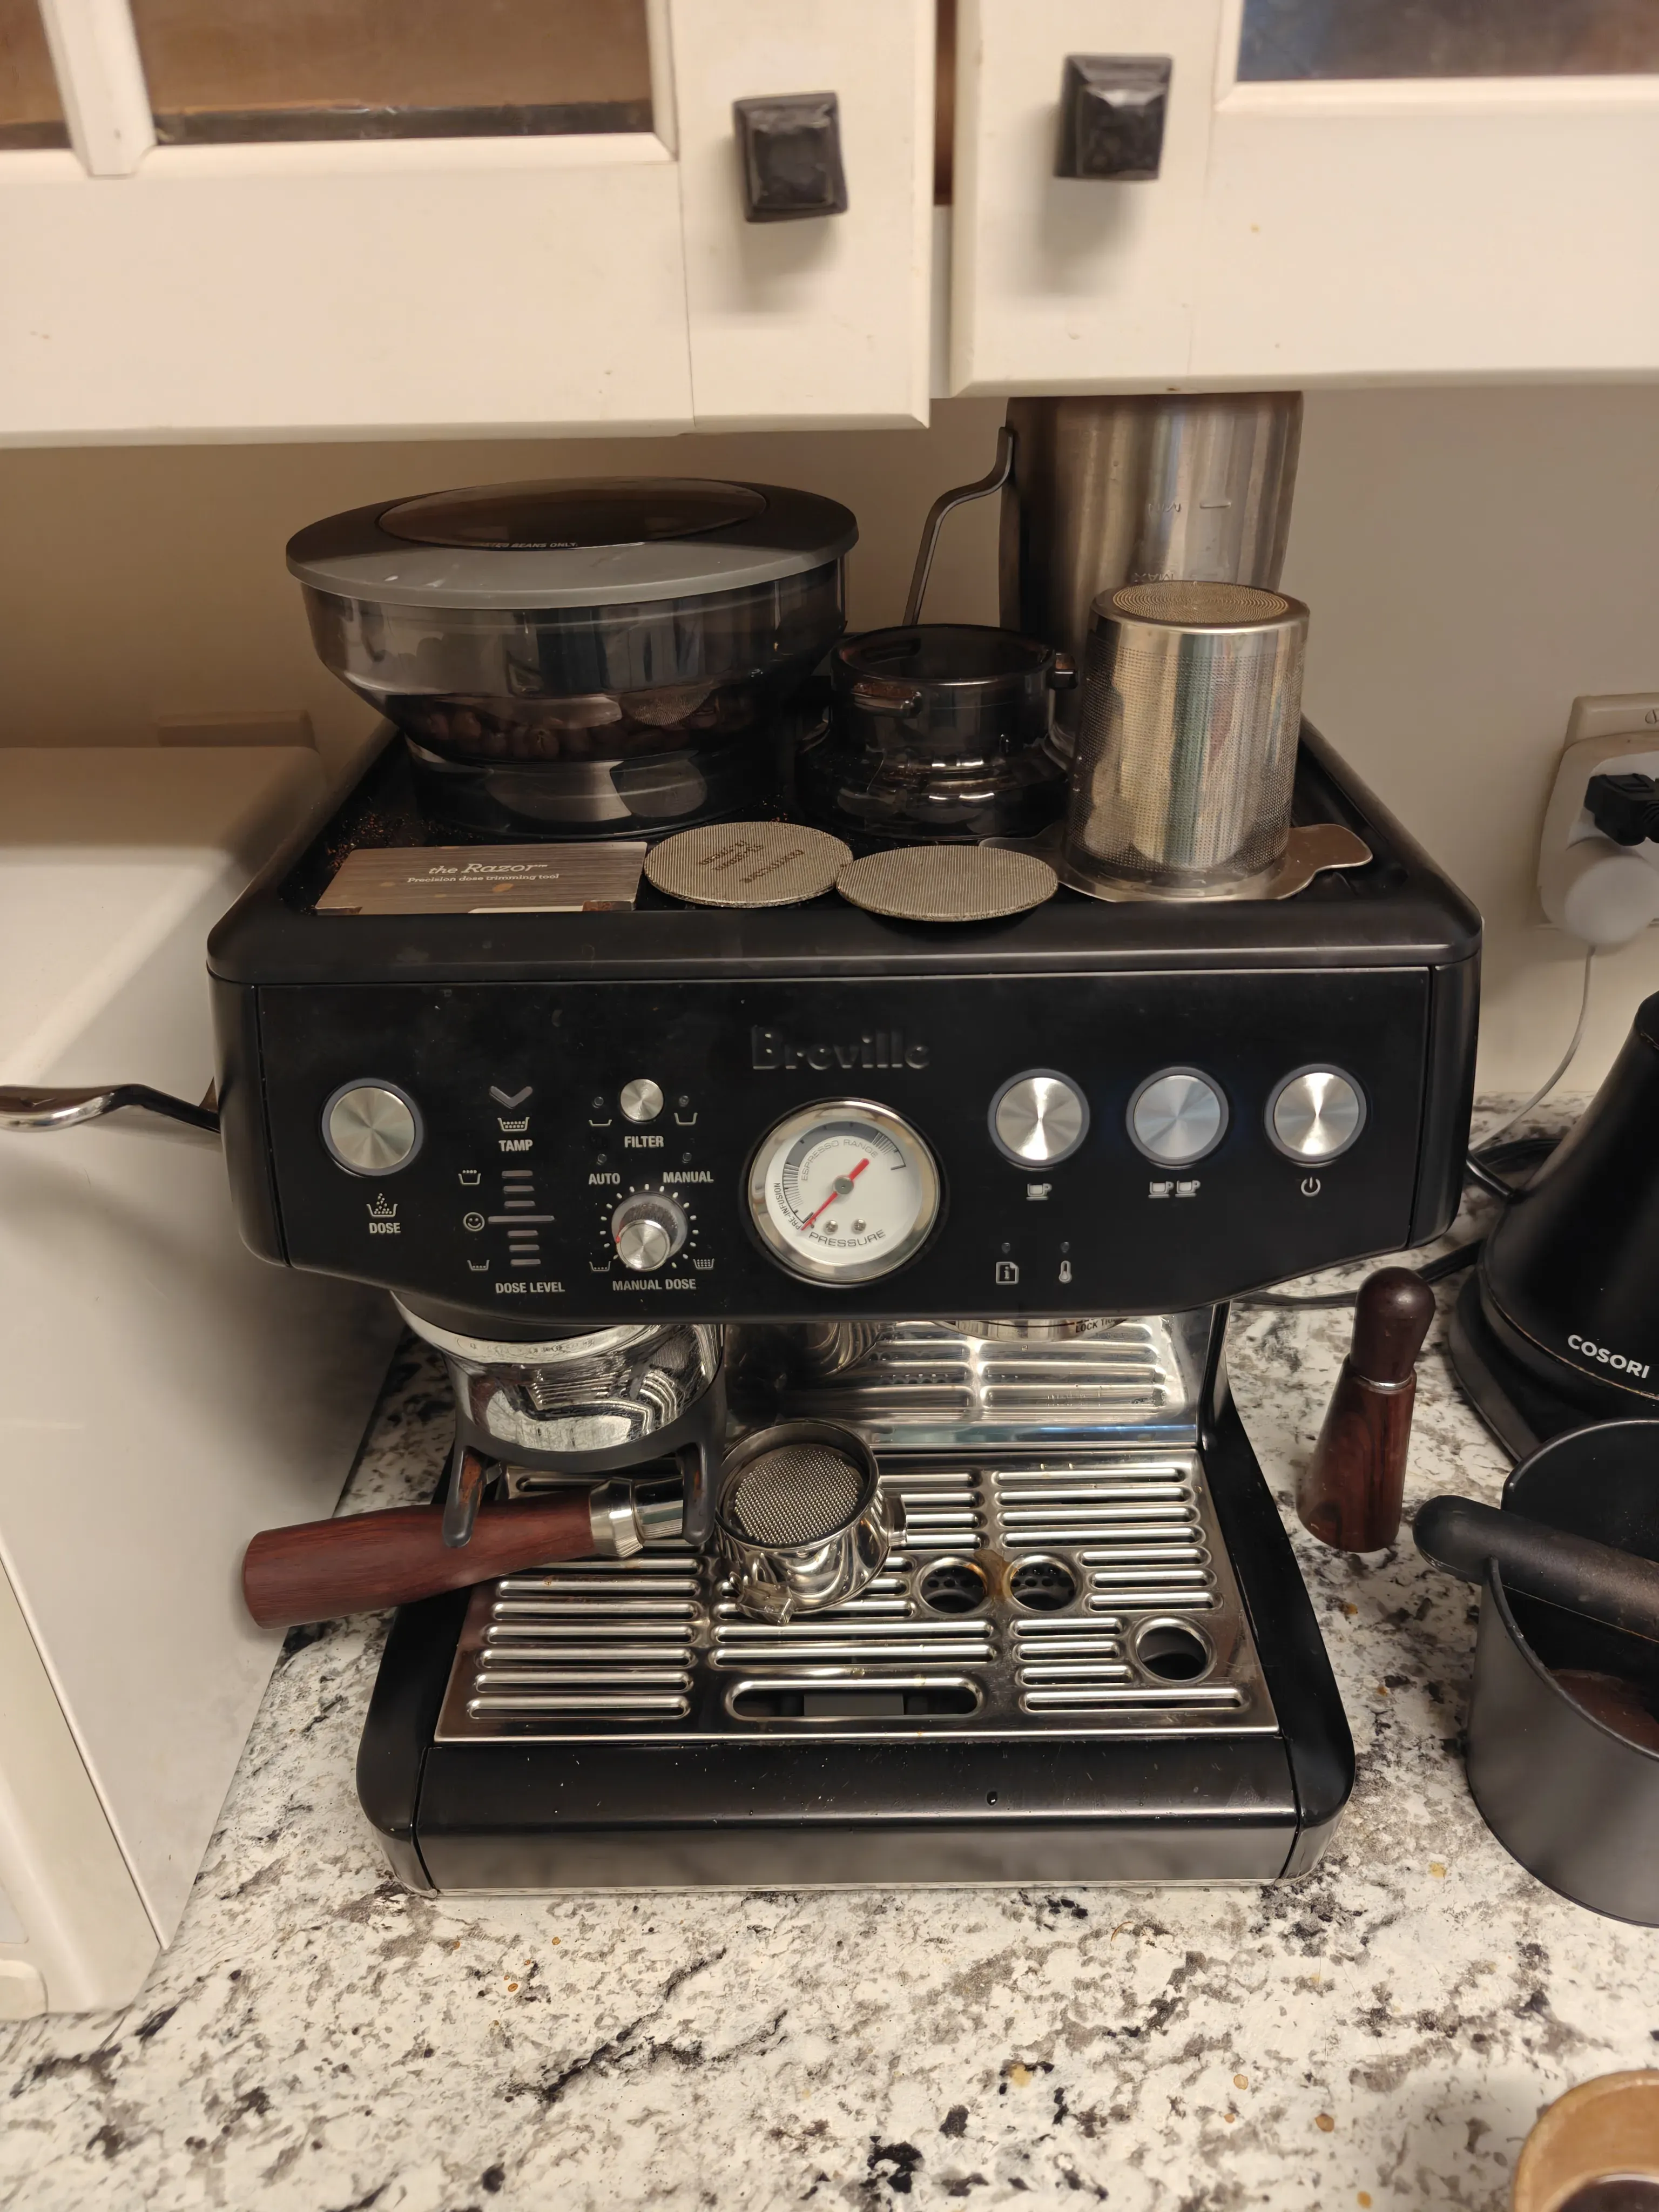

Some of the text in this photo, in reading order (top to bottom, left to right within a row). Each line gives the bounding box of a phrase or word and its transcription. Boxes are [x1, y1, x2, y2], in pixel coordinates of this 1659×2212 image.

[429, 866, 458, 874] the
[751, 1025, 930, 1070] Breville
[498, 1139, 533, 1151] TAMP
[624, 1136, 664, 1148] FILTER
[801, 1139, 879, 1181] ESPRESSO RANGE
[588, 1173, 621, 1185] AUTO
[663, 1171, 714, 1183] MANUAL
[773, 1183, 802, 1230] PRE-INFUSION
[369, 1223, 401, 1233] DOSE
[809, 1229, 886, 1247] PRESSURE
[495, 1282, 565, 1293] DOSE LEVEL
[612, 1278, 697, 1291] MANUAL DOSE
[1075, 1320, 1098, 1333] LOCK
[1568, 1334, 1650, 1378] COSORI
